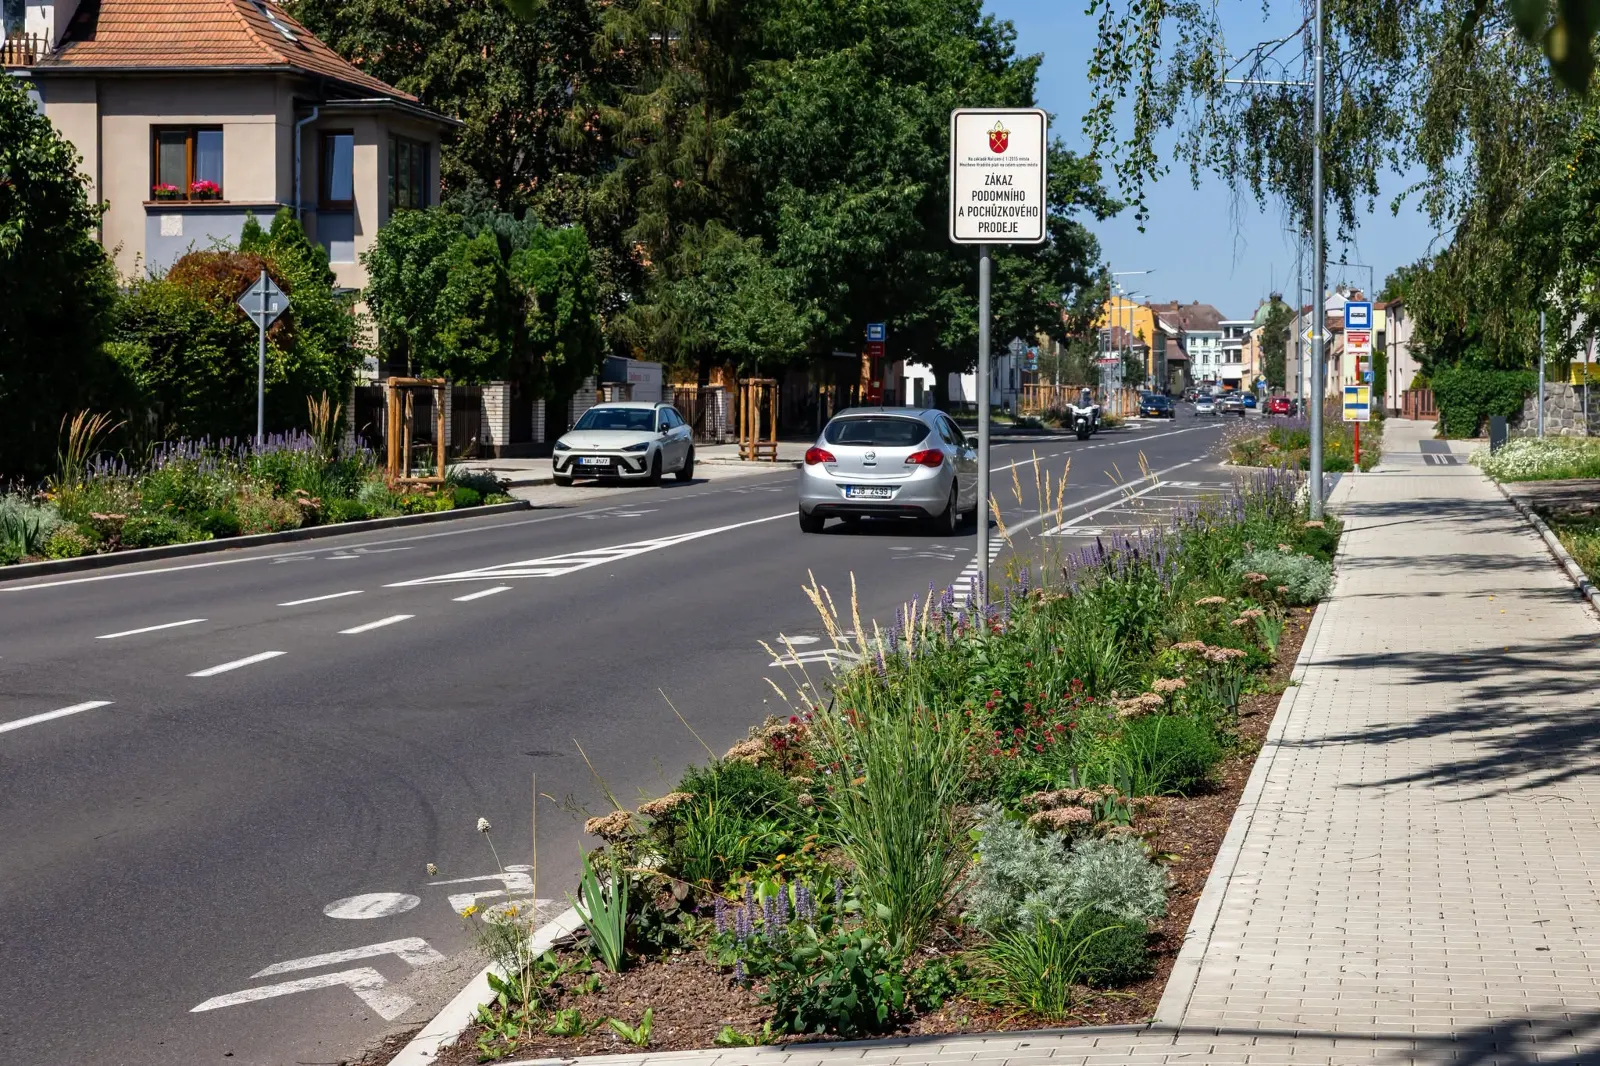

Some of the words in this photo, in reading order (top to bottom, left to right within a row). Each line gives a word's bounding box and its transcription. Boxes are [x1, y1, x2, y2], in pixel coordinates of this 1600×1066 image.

[985, 172, 1013, 186] ZÁKAZ
[972, 188, 1026, 201] PODOMNÍHO
[958, 206, 964, 217] A
[967, 203, 1038, 217] POCHŮZKOVÉHO
[978, 222, 1018, 233] PRODEJE
